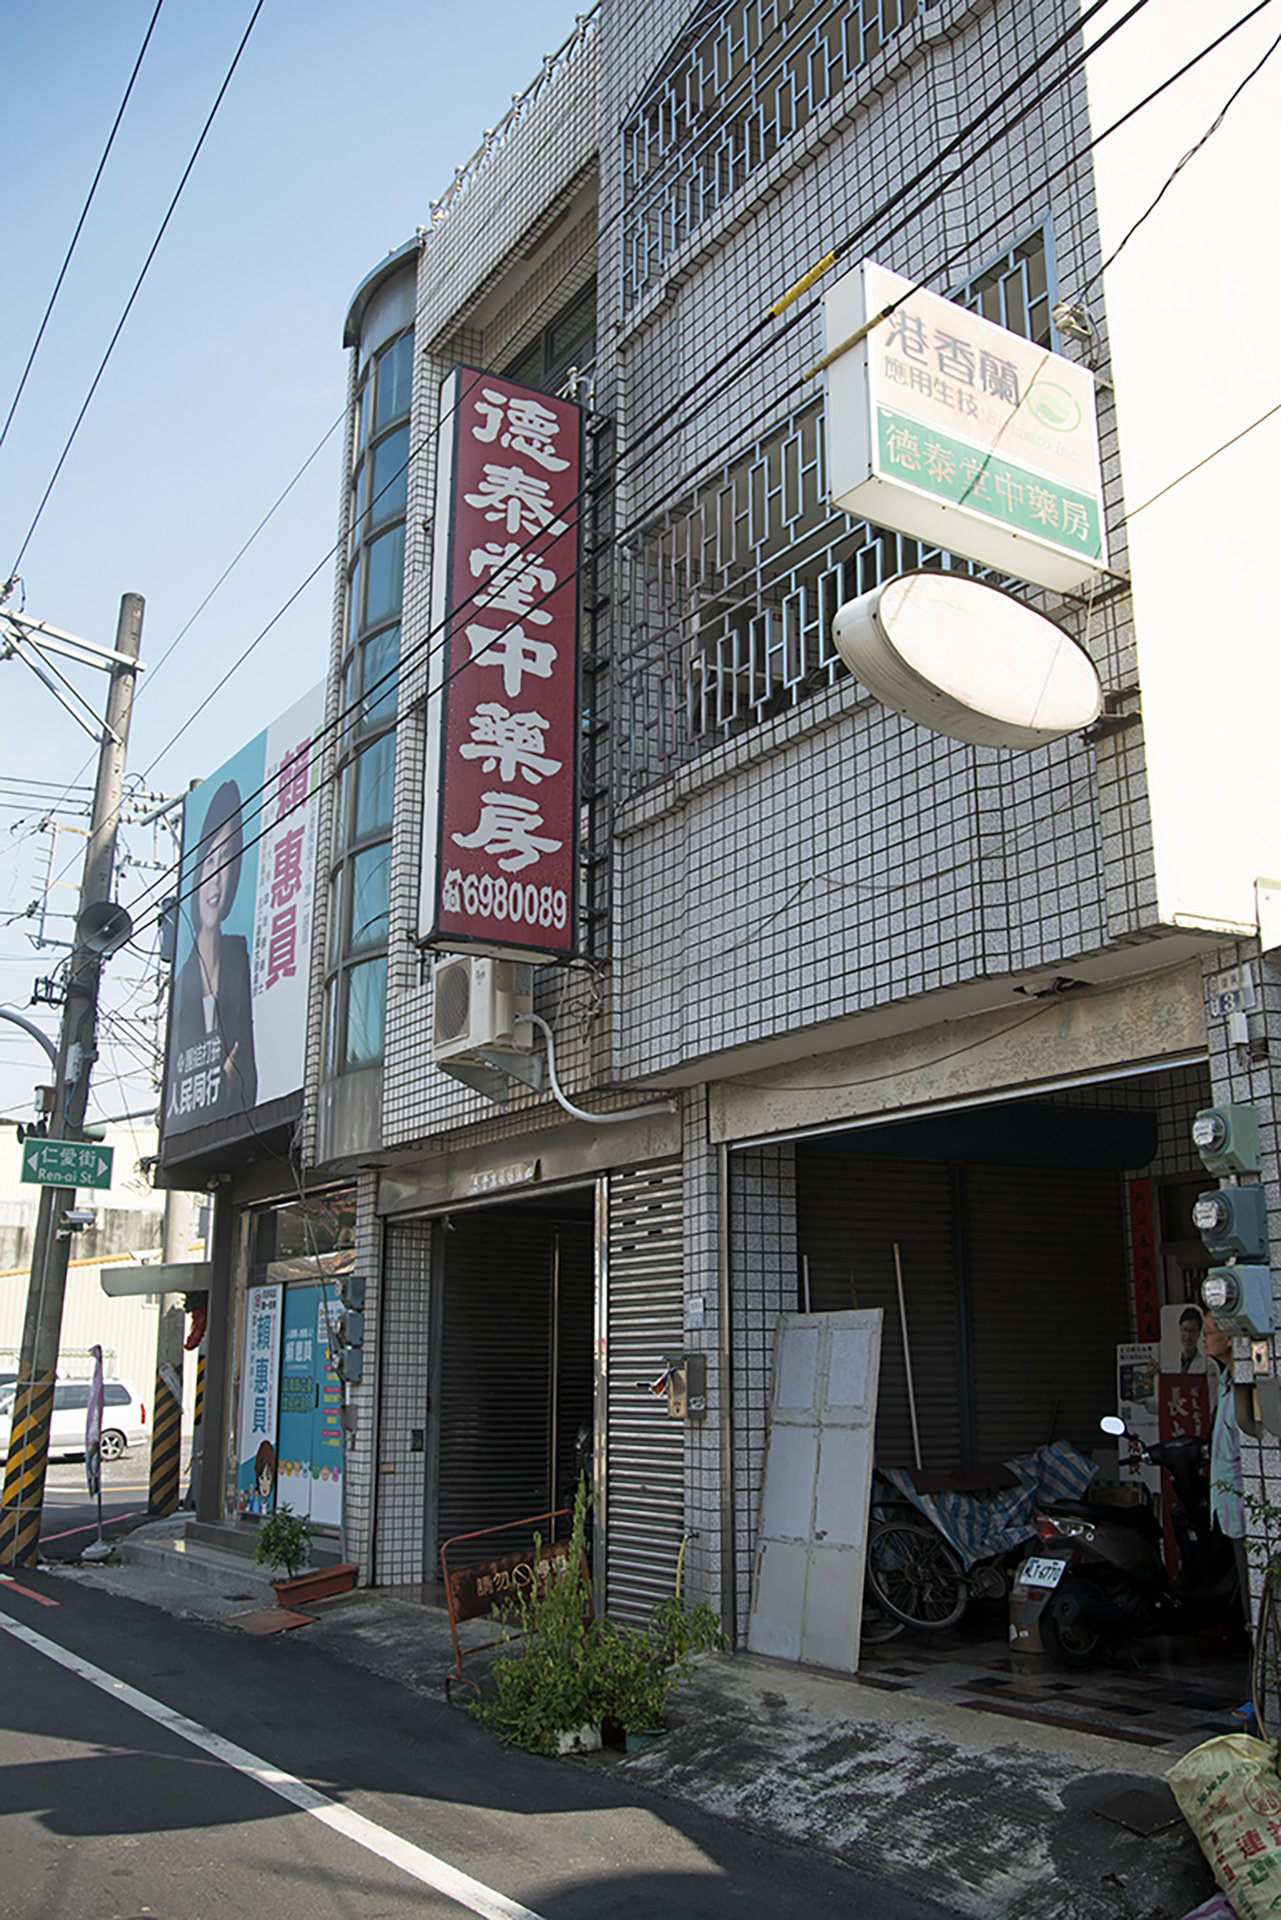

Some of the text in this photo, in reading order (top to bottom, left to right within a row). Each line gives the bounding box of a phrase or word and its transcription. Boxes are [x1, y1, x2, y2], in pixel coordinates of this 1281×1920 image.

[884, 306, 1021, 408] 港香蘭
[884, 355, 979, 420] 應用生技
[885, 422, 1091, 542] 德泰堂中藥房
[451, 387, 570, 872] 德泰堂中藥房
[462, 873, 568, 930] 6980089
[166, 1065, 221, 1118] 人民同行
[41, 1146, 97, 1168] 仁愛街
[79, 1171, 96, 1185] St.
